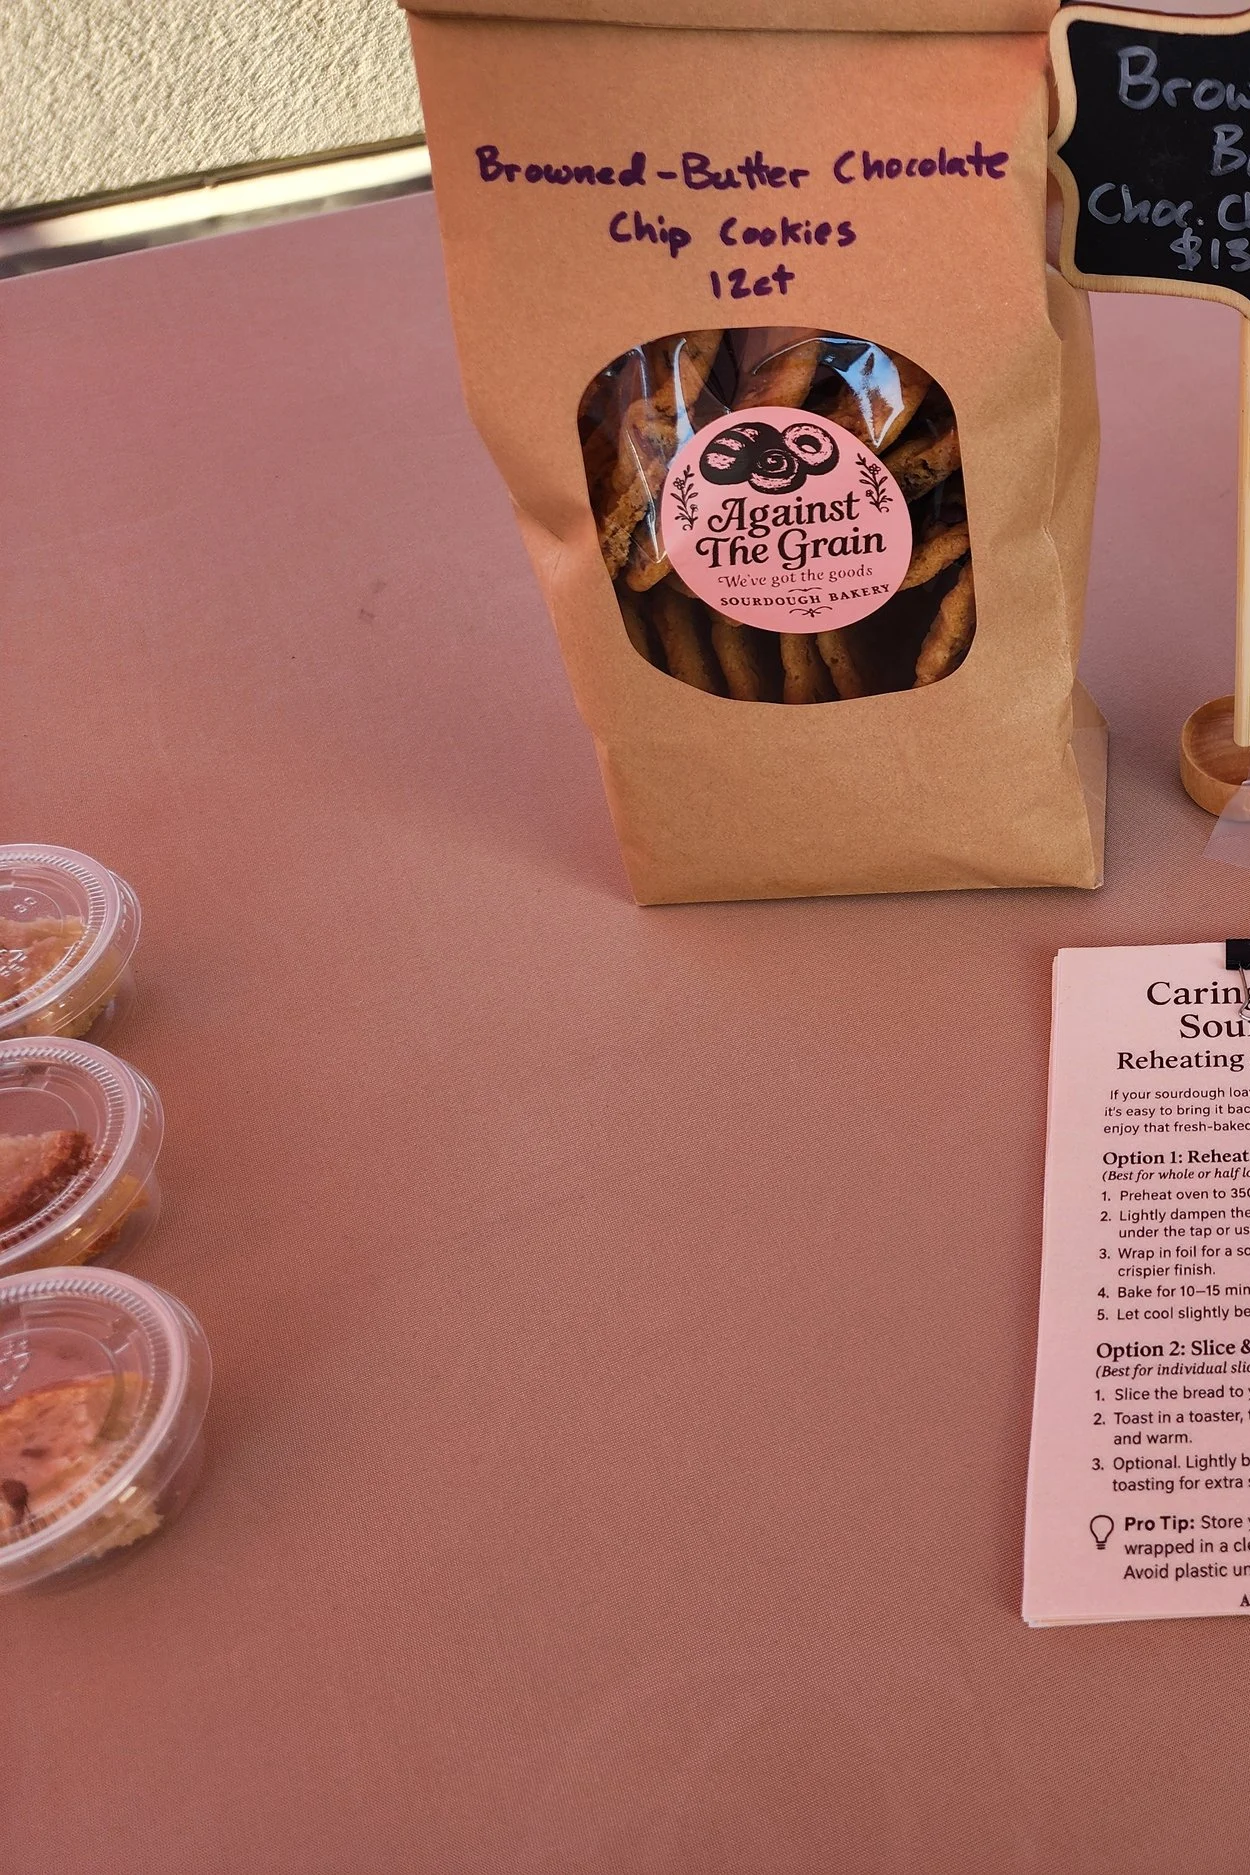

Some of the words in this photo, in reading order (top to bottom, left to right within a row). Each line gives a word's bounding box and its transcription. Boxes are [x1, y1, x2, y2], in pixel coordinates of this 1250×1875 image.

[834, 141, 1008, 185] Chocolate
[1088, 182, 1205, 228] Choc.
[609, 211, 691, 258] Chip
[719, 218, 856, 248] Cookies
[707, 491, 861, 538] Against
[696, 536, 769, 568] The
[778, 527, 887, 570] Grain
[718, 574, 767, 588] We've
[771, 572, 795, 587] got
[801, 569, 824, 582] the
[829, 564, 872, 582] goods
[720, 595, 821, 606] SOURDOUGH
[829, 584, 890, 602] BAKERY
[1116, 1049, 1245, 1073] Reheating
[1109, 1088, 1120, 1101] If
[1121, 1091, 1152, 1103] your
[1154, 1086, 1226, 1101] sourdough
[1102, 1150, 1166, 1169] Option
[1169, 1150, 1183, 1165] 1:
[1186, 1148, 1250, 1164] Reheat
[1102, 1170, 1133, 1182] (Best
[1135, 1169, 1155, 1183] for
[1158, 1167, 1195, 1180] whole
[1197, 1171, 1211, 1180] or
[1214, 1166, 1241, 1181] half
[1096, 1308, 1109, 1321] 5.
[1116, 1308, 1140, 1321] Let
[1143, 1305, 1174, 1320] cool
[1177, 1304, 1230, 1323] slightly
[1095, 1340, 1165, 1363] Option
[1168, 1340, 1186, 1357] 2:
[1190, 1338, 1237, 1357] Slice
[1095, 1364, 1130, 1379] (Best
[1132, 1363, 1154, 1380] for
[1157, 1362, 1227, 1376] individual
